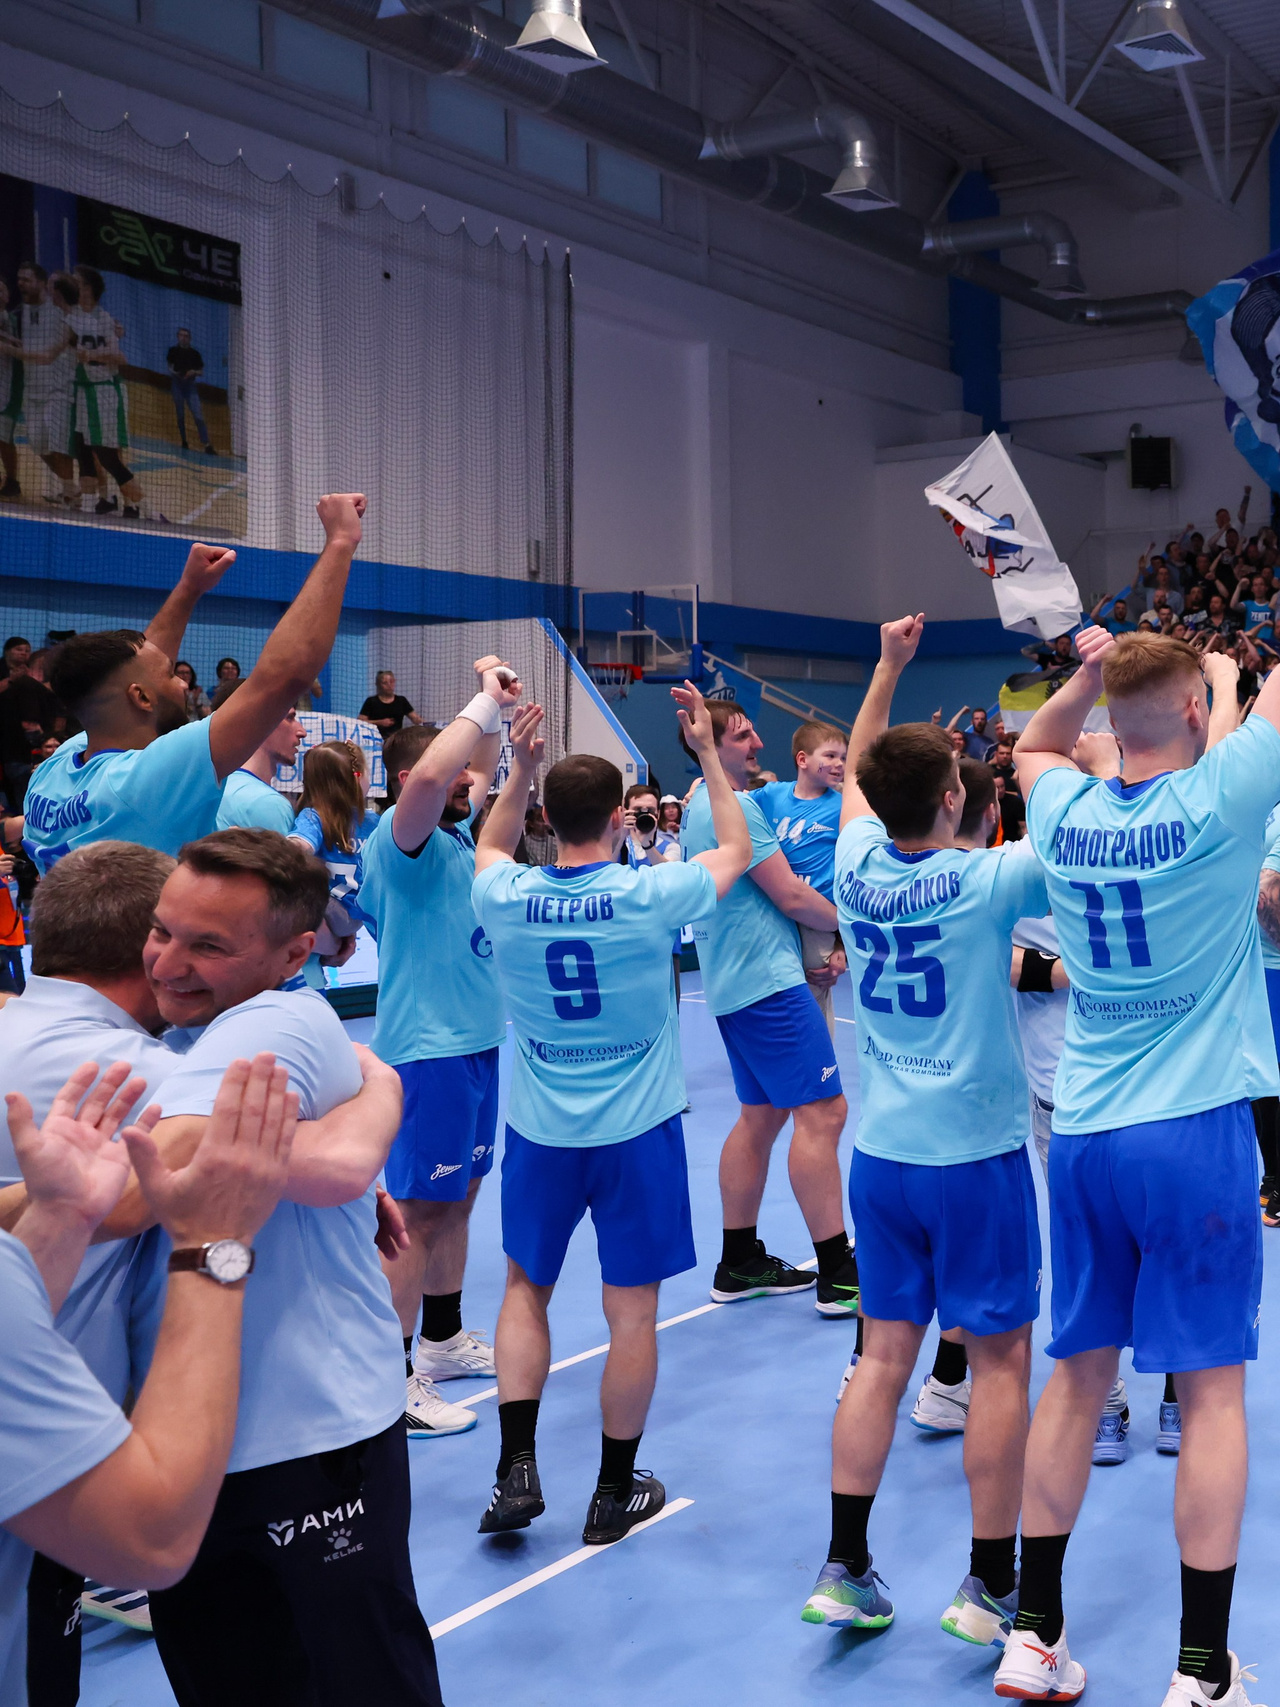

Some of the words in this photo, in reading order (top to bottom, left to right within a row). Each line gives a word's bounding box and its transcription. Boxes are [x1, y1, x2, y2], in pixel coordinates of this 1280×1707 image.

[1055, 821, 1187, 870] ВИНОГРАДОВ
[526, 893, 614, 924] ПЕТРОВ
[1068, 879, 1152, 969] 11
[850, 920, 947, 1018] 25
[545, 939, 602, 1021] 9
[1086, 1000, 1121, 1013] NORD
[1125, 992, 1198, 1012] COMPANY
[1101, 1012, 1145, 1021] СЕВЕРНАЯ
[548, 1047, 584, 1058] NORD
[588, 1037, 652, 1056] COMPANY
[564, 1056, 606, 1064] СЕВЕРНАЯ
[896, 1054, 954, 1071] COMPANY
[911, 1068, 951, 1077] КОМПАНИЯ
[301, 1498, 365, 1533] АМИ
[324, 1542, 364, 1563] KELME
